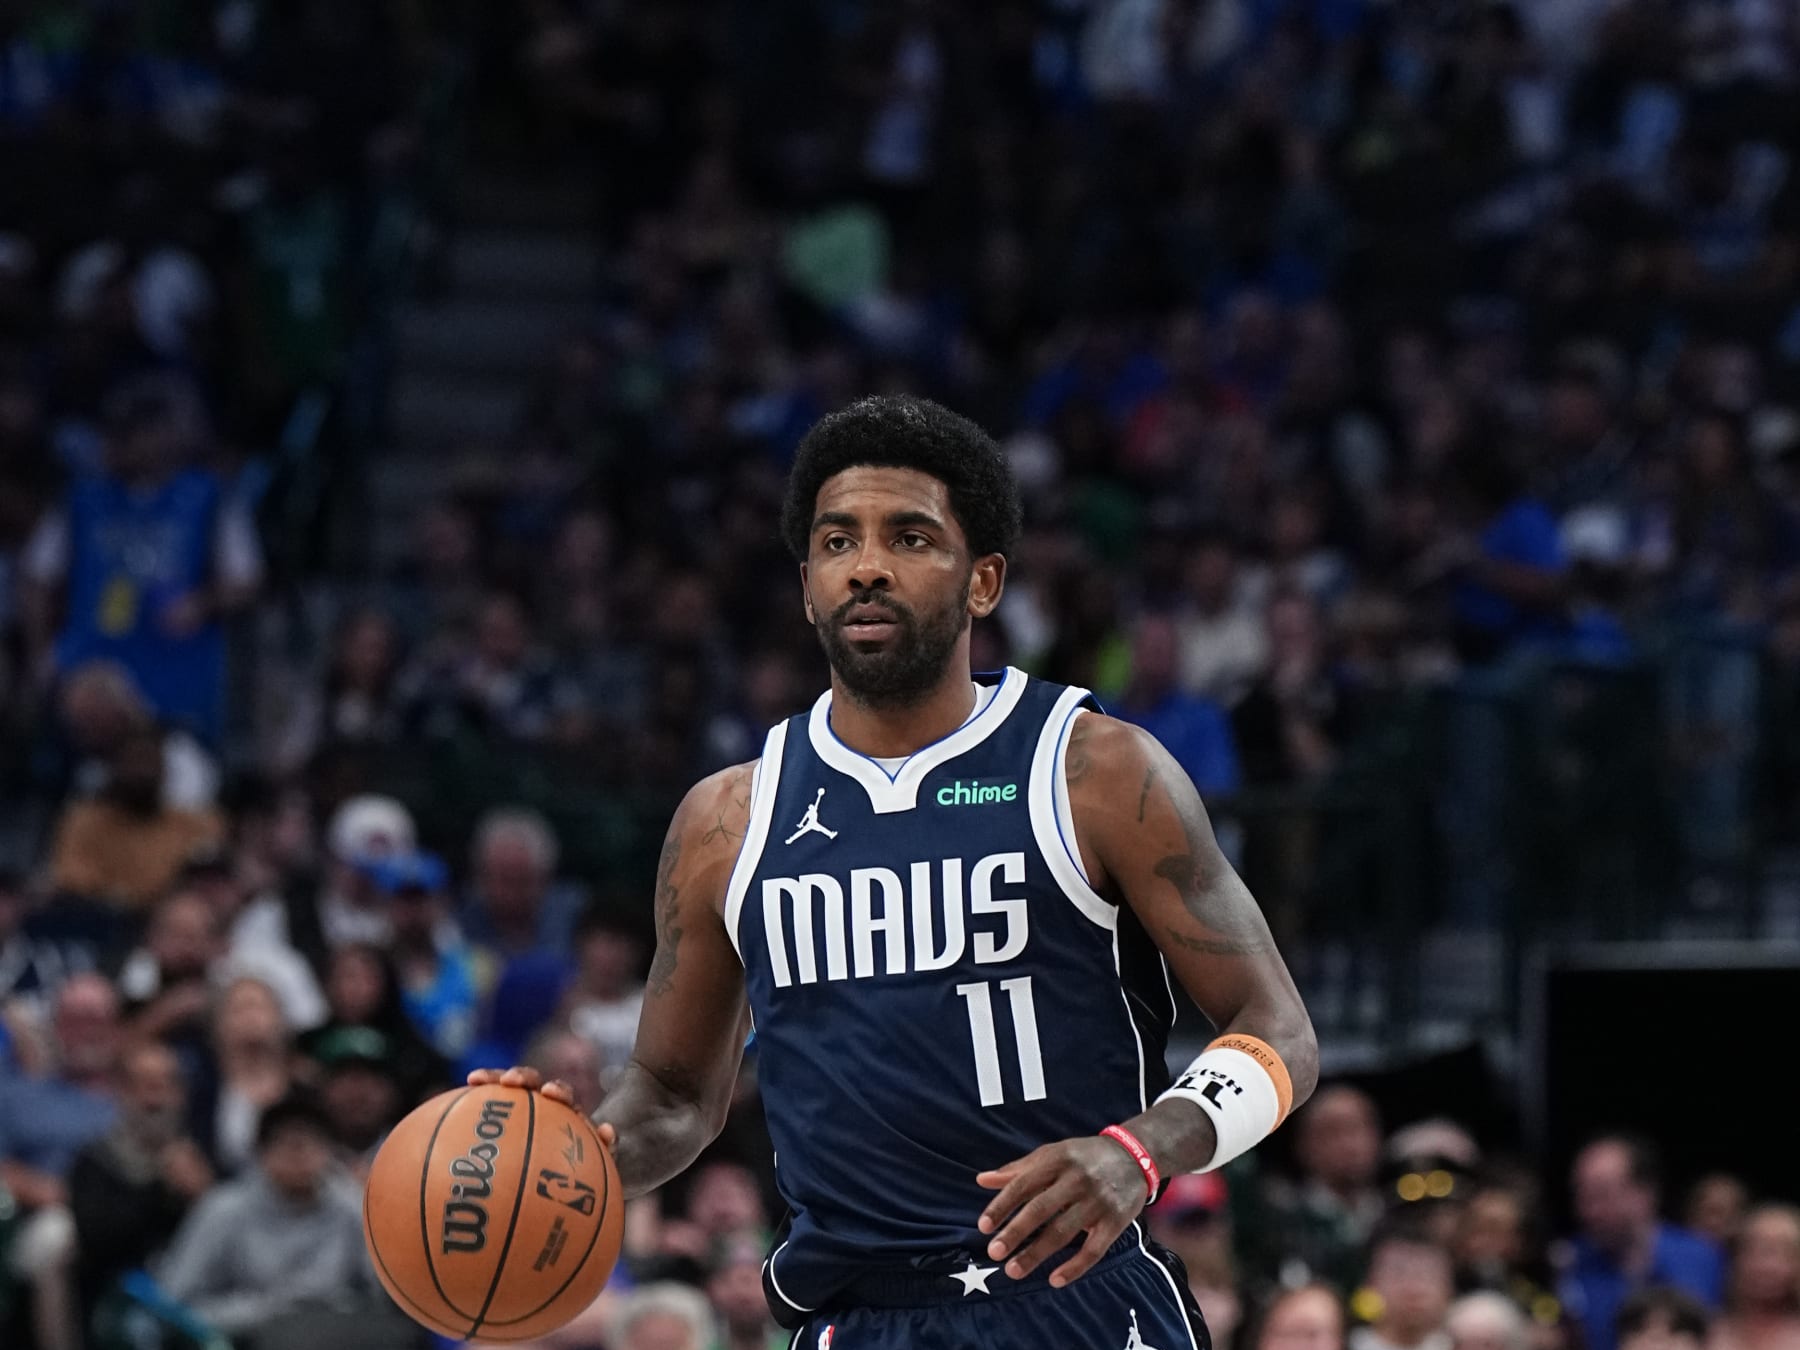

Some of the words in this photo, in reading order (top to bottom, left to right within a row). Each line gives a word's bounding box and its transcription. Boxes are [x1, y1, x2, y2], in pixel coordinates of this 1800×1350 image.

[937, 781, 1017, 805] chime
[762, 852, 1028, 988] MAVS
[957, 976, 1047, 1107] 11
[442, 1099, 515, 1256] Wilson
